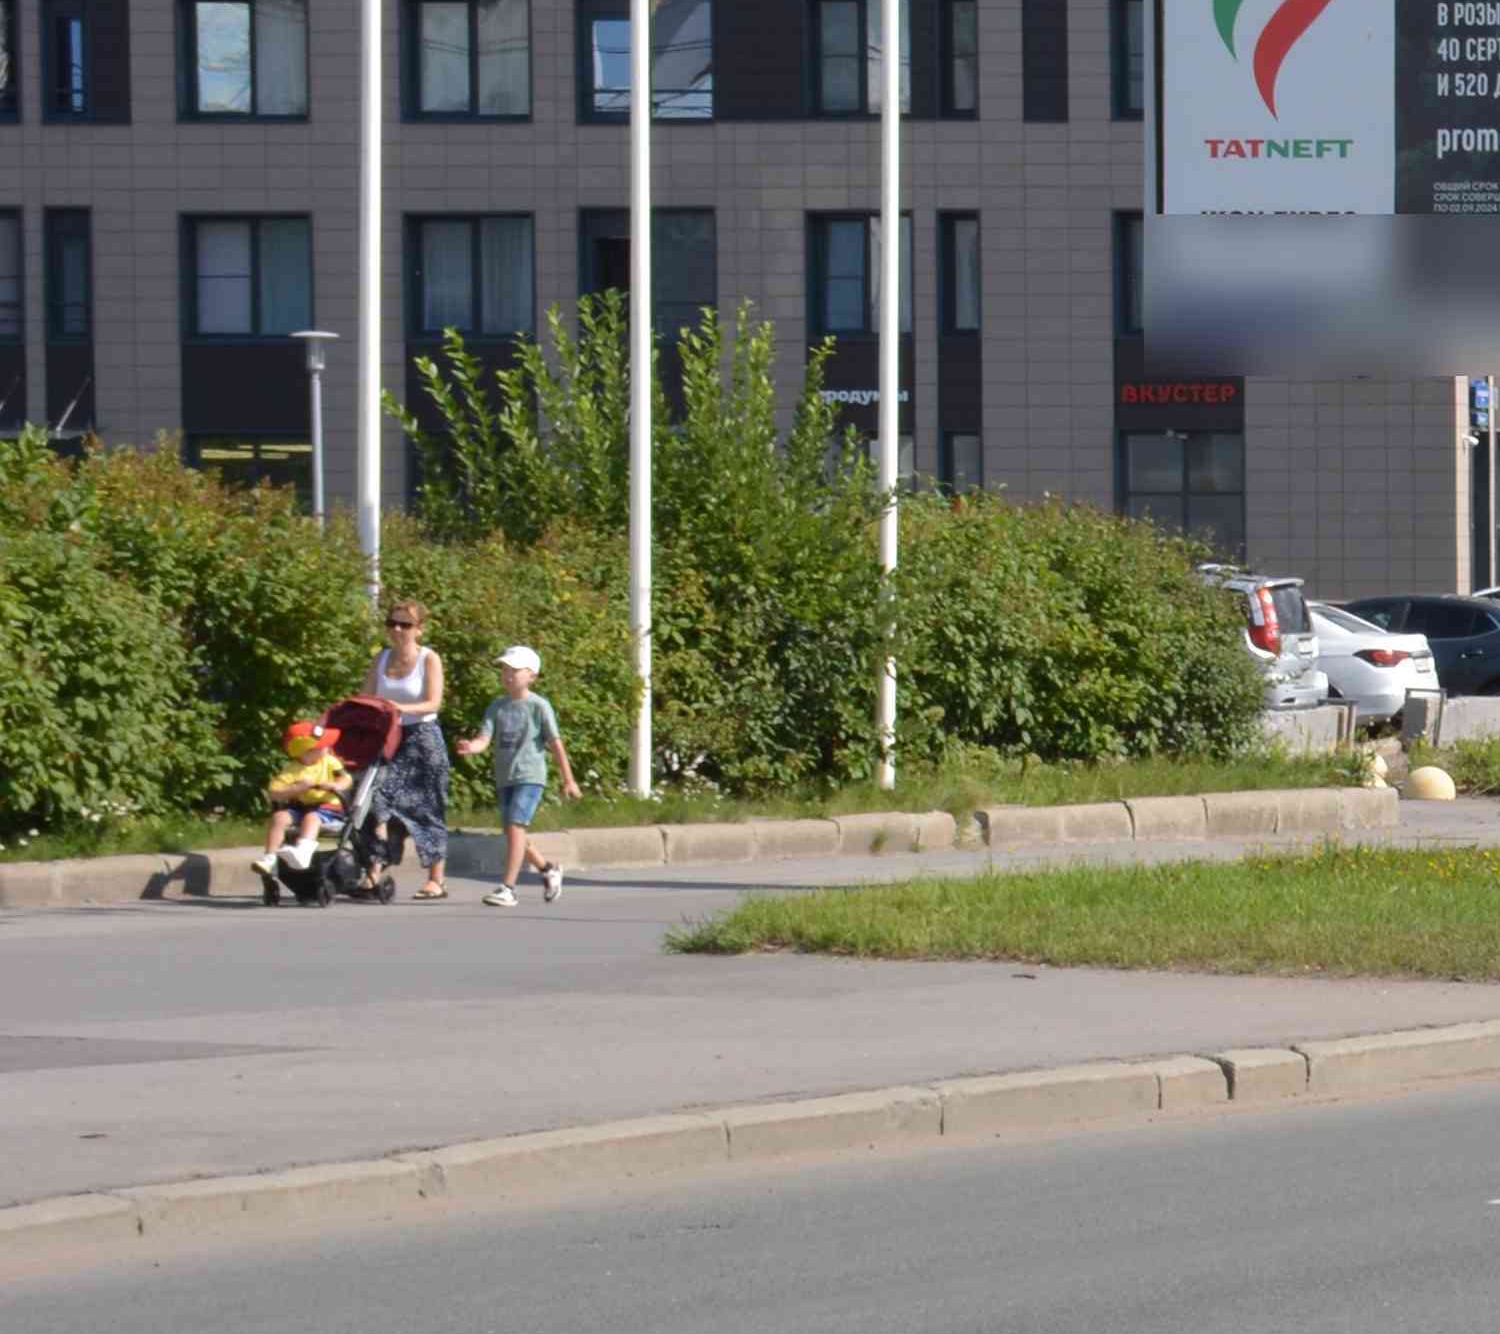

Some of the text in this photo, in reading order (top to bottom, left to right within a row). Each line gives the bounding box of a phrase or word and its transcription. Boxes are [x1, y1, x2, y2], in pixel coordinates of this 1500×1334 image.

[1437, 3, 1449, 27] В
[1437, 39, 1460, 62] 40
[1437, 73, 1449, 97] И
[1455, 73, 1489, 96] 520
[1204, 138, 1354, 159] TATNEFT
[1121, 383, 1239, 404] ВКУСТЕР
